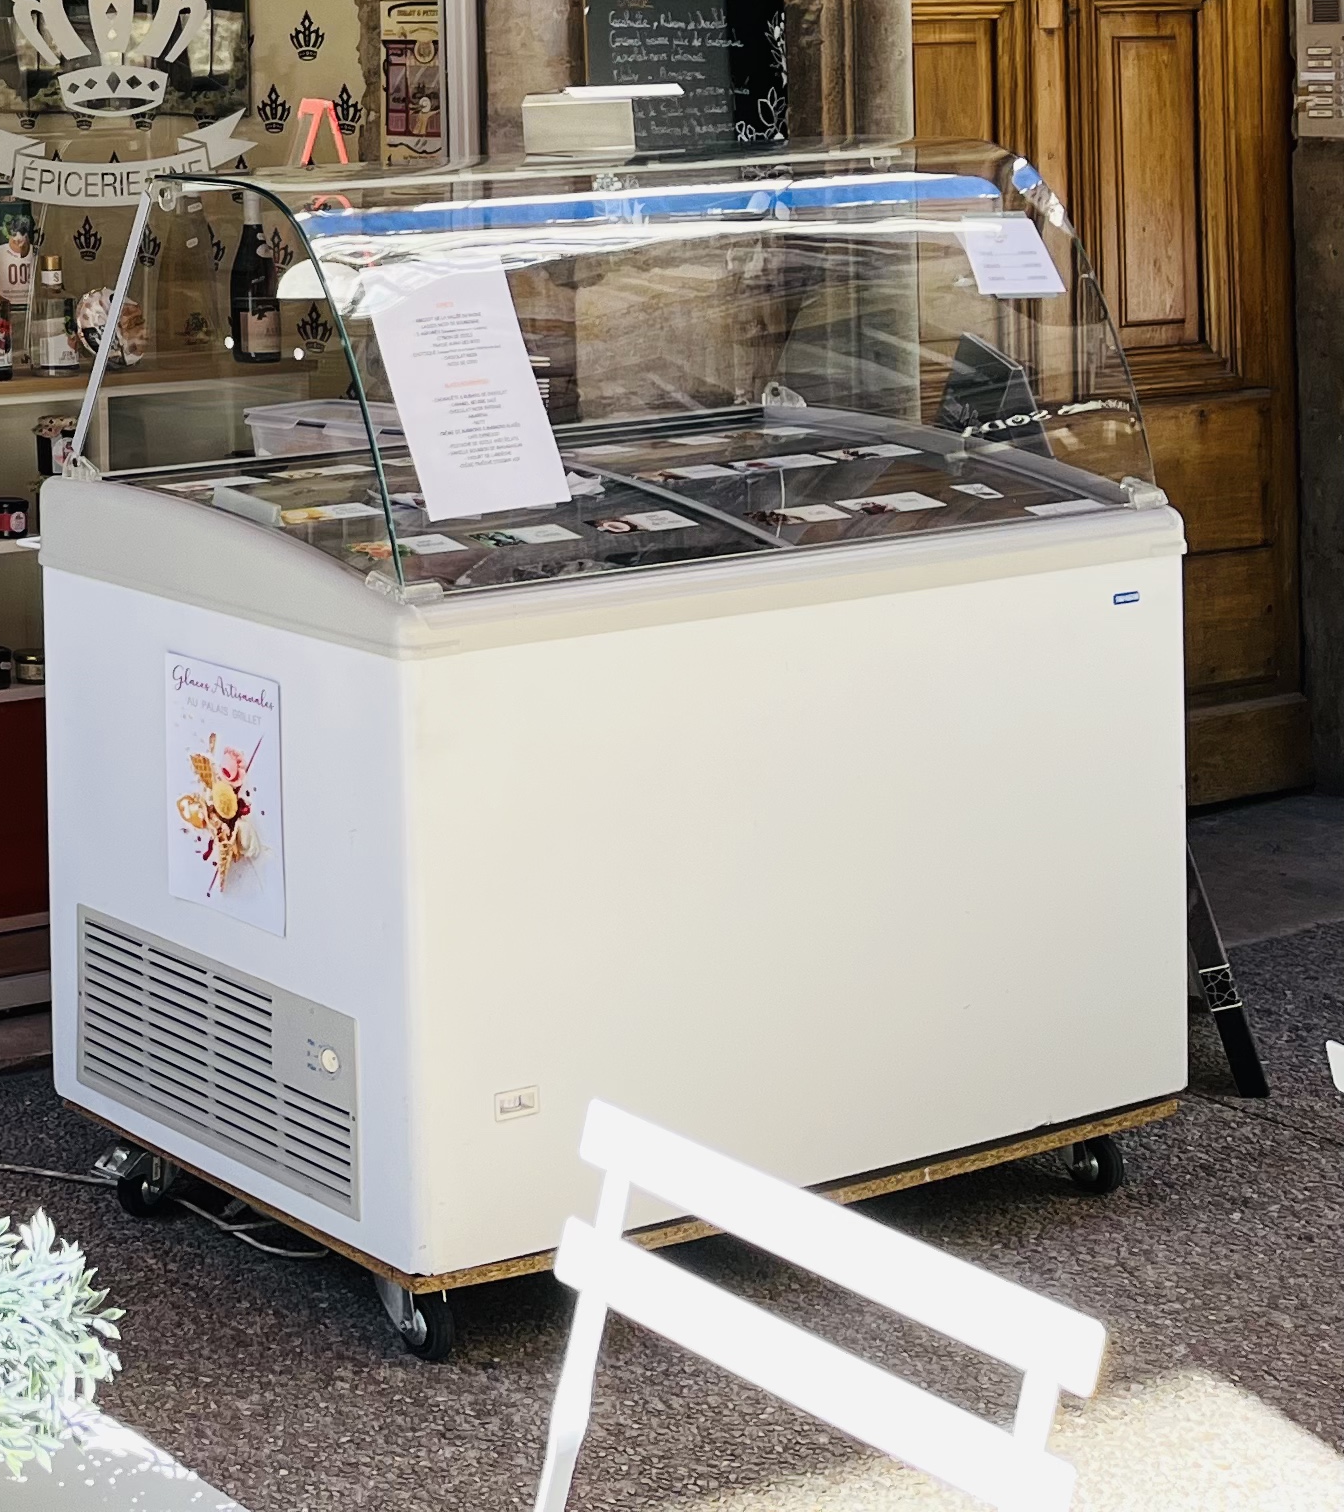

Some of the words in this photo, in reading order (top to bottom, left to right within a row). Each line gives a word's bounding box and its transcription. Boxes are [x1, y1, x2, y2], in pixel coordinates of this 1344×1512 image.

[20, 160, 141, 198] ÉPICERIE
[172, 664, 210, 691] Glaces
[211, 675, 276, 712] Artisanales
[186, 695, 198, 708] AU
[201, 699, 229, 718] PALAIS
[232, 708, 262, 728] GRILLET
